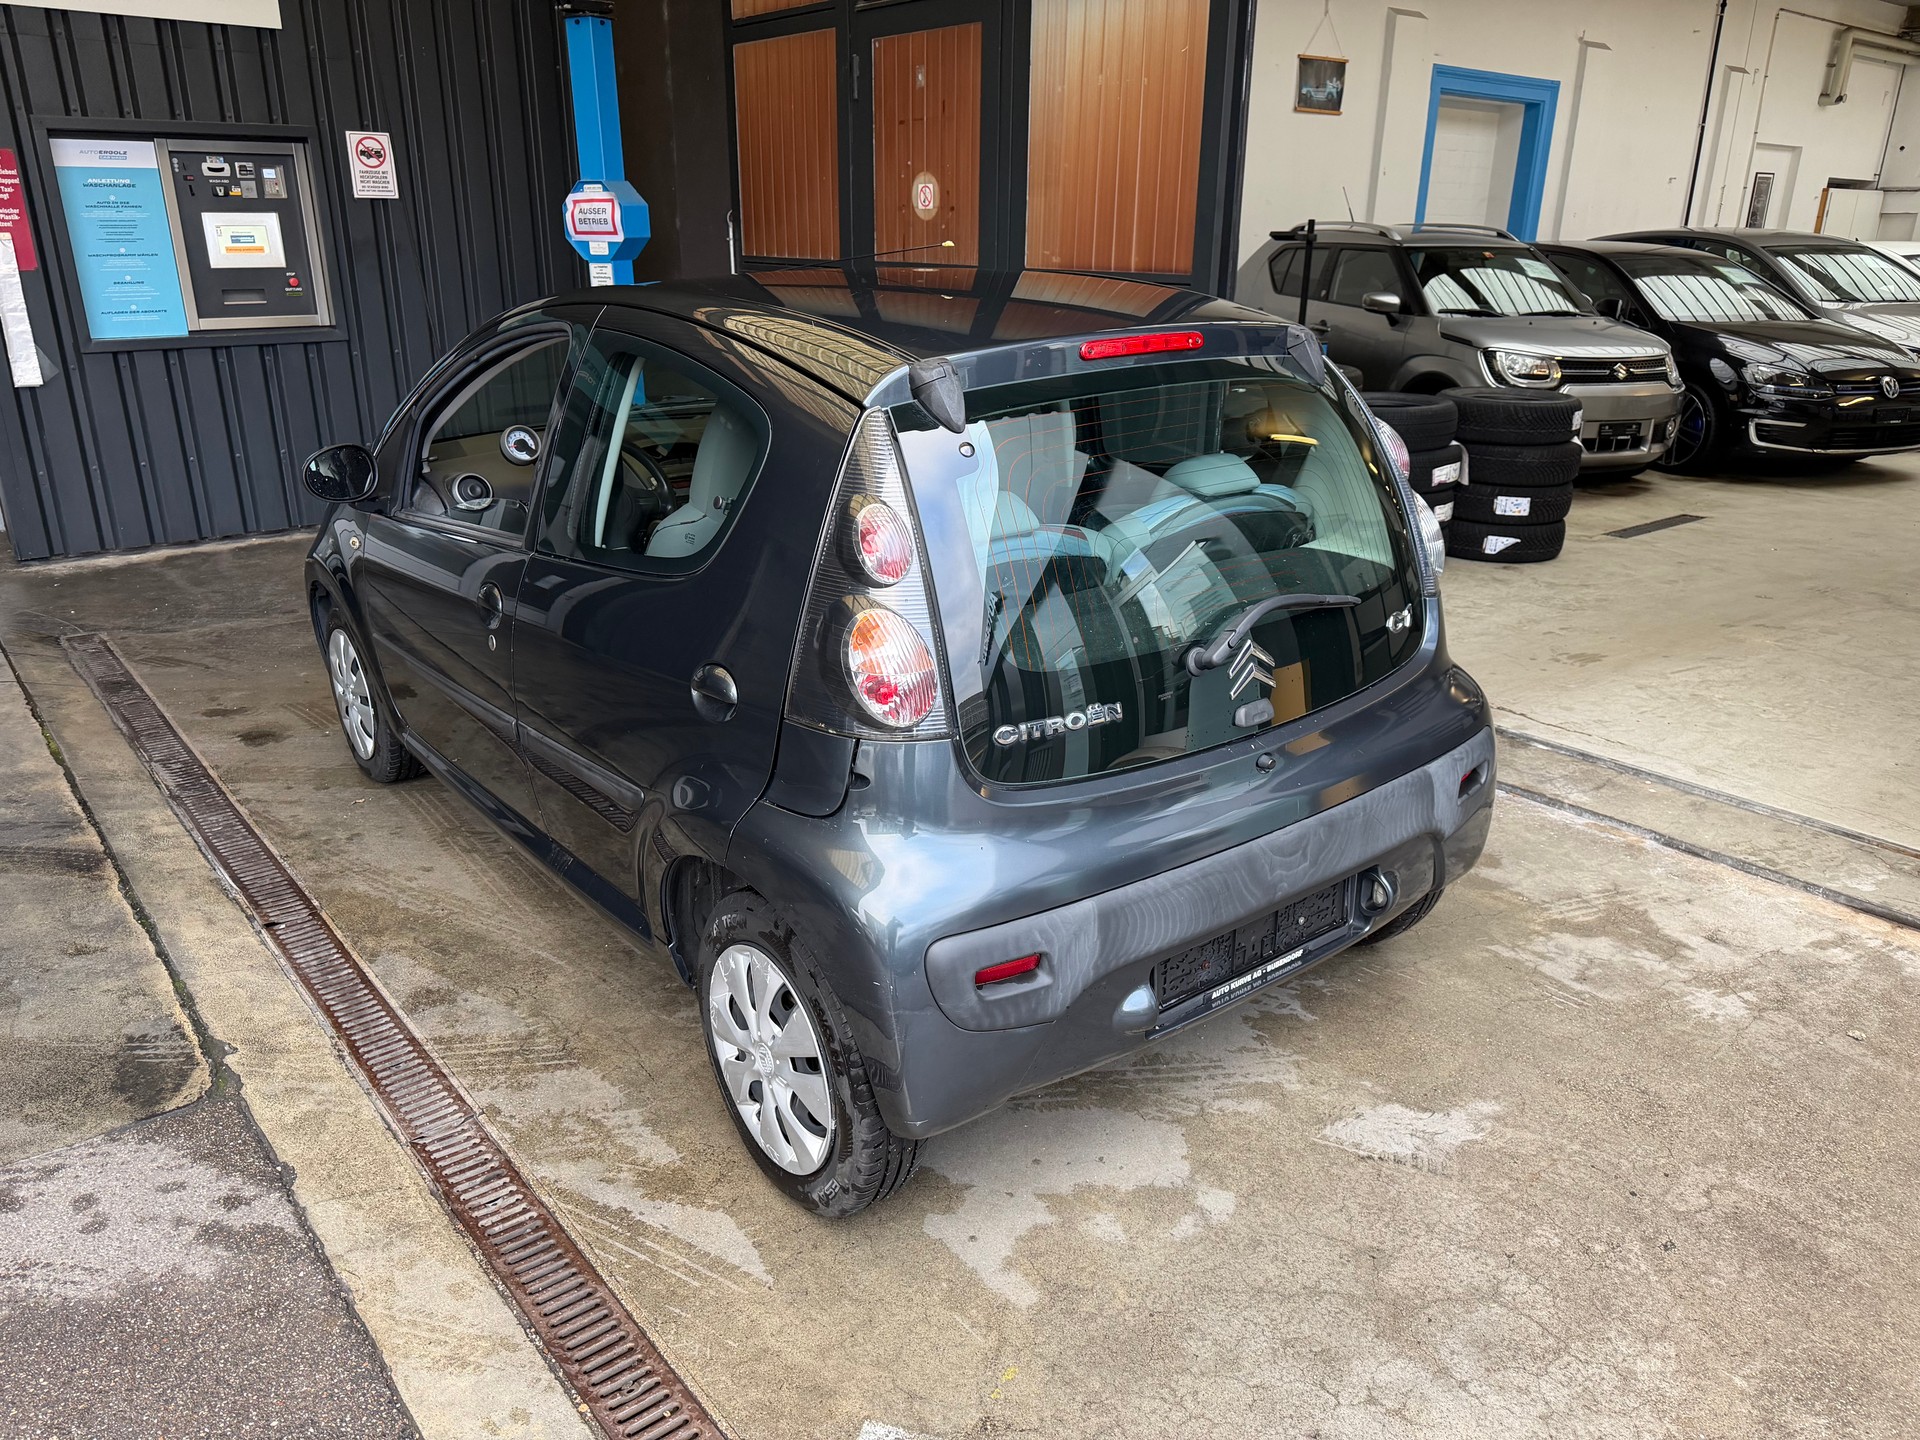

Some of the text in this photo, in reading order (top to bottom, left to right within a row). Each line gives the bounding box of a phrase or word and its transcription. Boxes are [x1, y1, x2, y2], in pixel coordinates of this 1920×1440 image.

[578, 207, 607, 215] AUSSER
[578, 217, 609, 226] BETRIEB
[993, 702, 1123, 746] CITROËN
[1211, 986, 1230, 999] AUTO
[1230, 974, 1252, 990] KURVE
[1266, 949, 1304, 972] BUBENDORF
